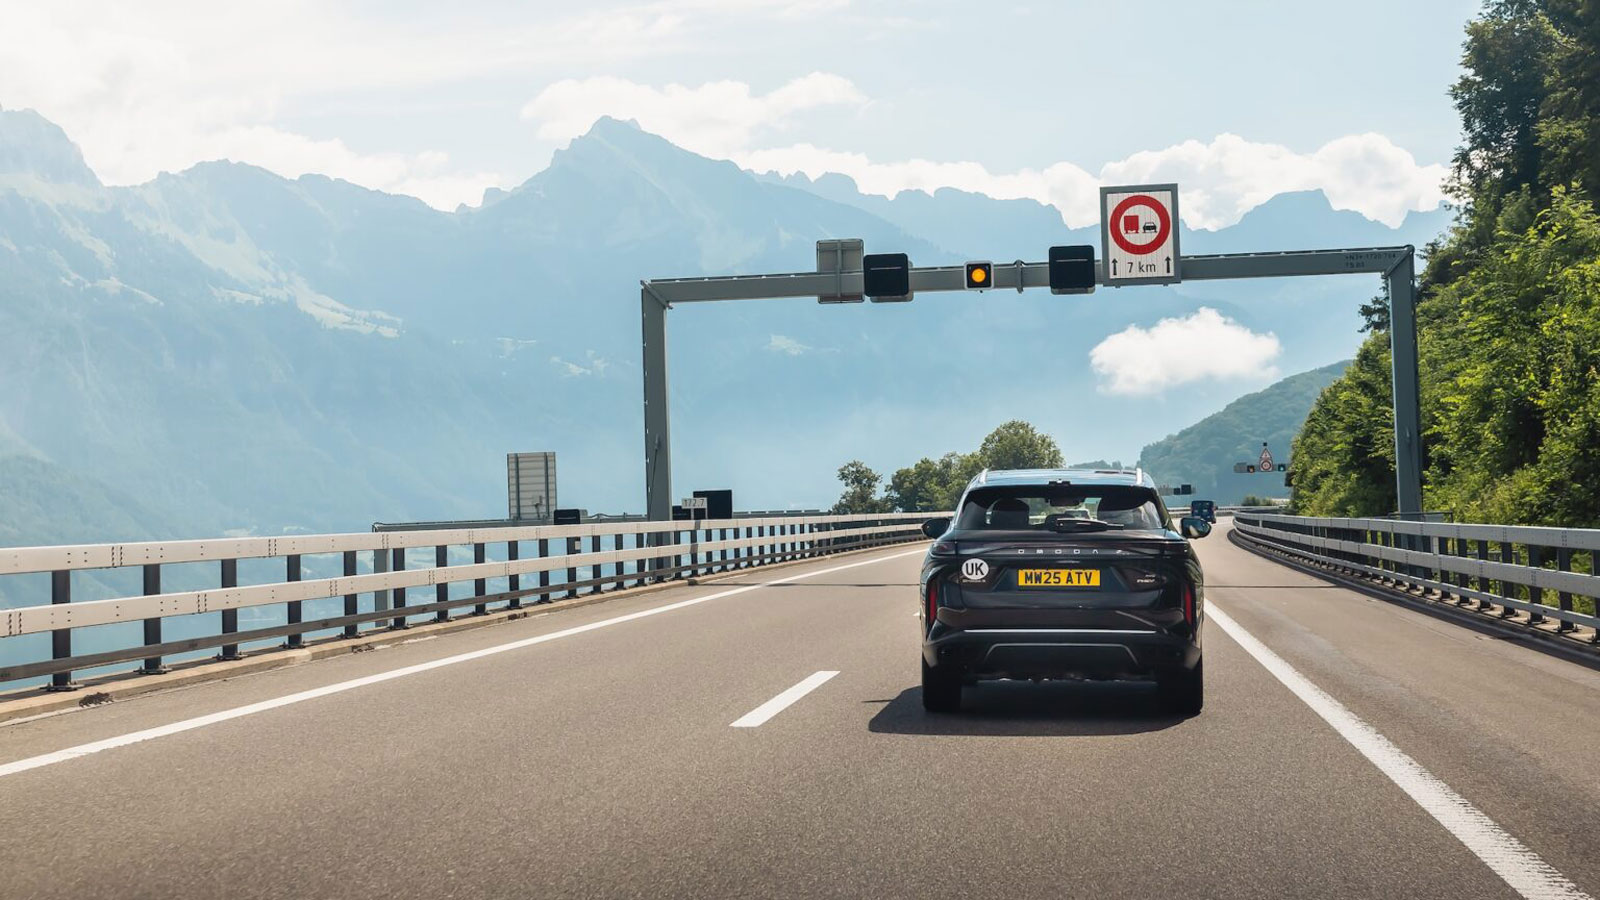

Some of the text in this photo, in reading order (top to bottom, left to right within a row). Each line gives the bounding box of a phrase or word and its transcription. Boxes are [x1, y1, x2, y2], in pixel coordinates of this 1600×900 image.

[1127, 261, 1156, 273] 7 km
[684, 498, 705, 508] 172.7
[965, 562, 985, 576] UK
[1024, 571, 1093, 584] MW25 ATV
